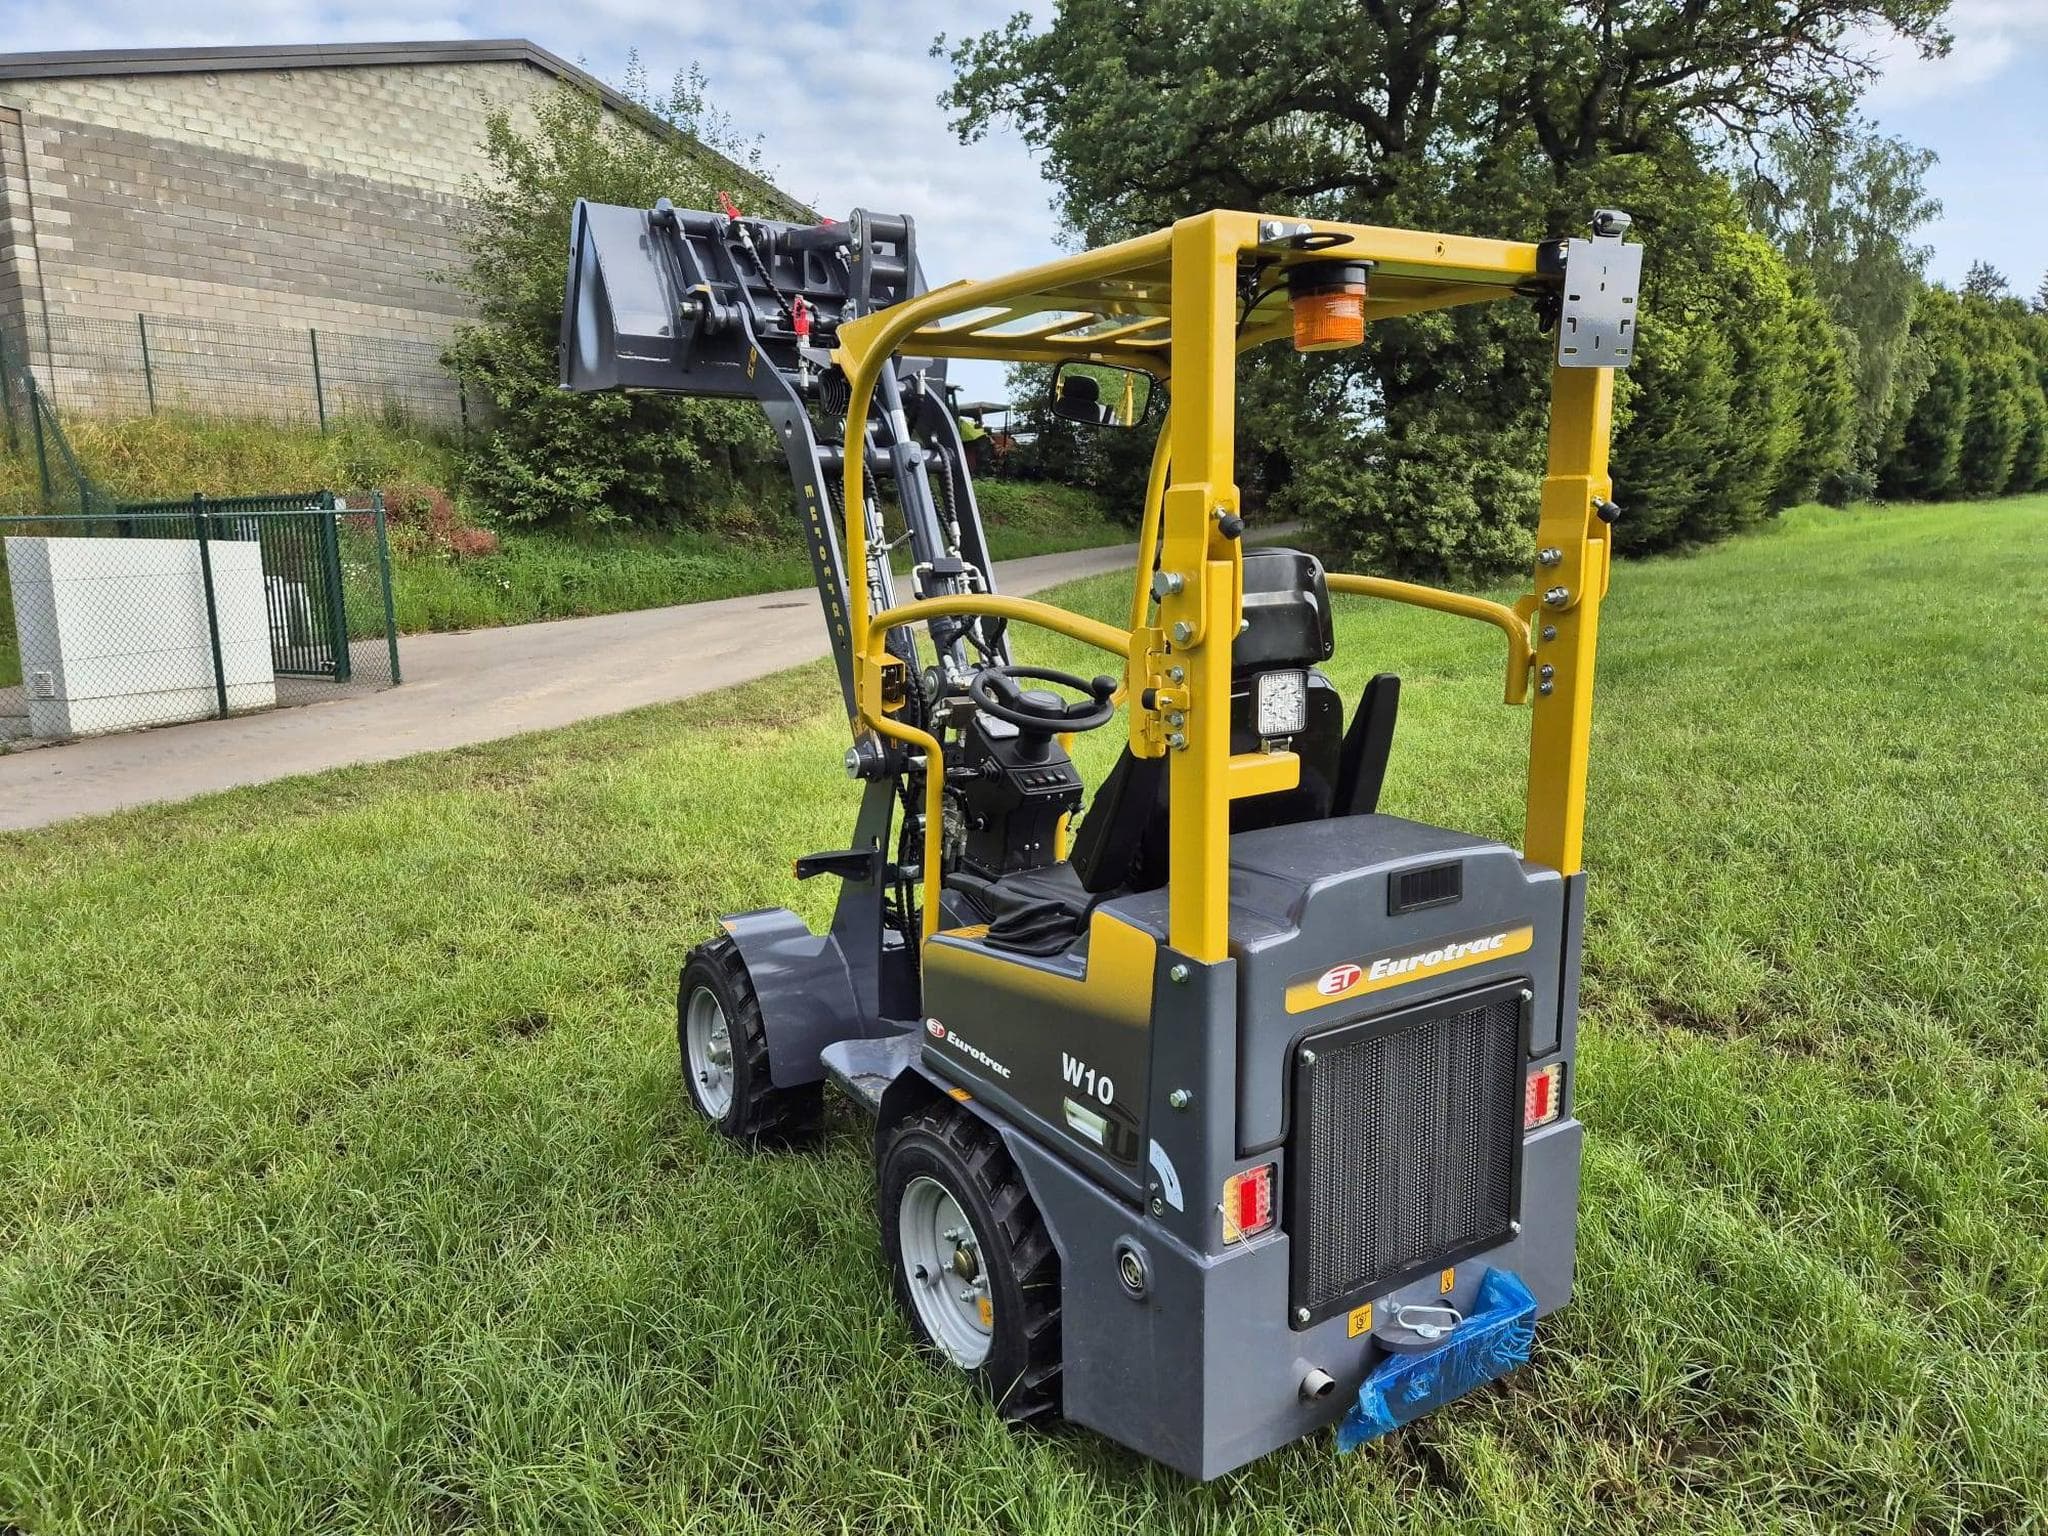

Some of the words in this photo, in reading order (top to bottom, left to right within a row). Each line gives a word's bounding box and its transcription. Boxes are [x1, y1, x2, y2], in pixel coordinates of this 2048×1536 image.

[803, 484, 846, 638] Eurotrac
[1367, 933, 1508, 982] Eurotrac
[946, 1030, 1012, 1080] Eurotrac
[1062, 1051, 1115, 1106] W10
